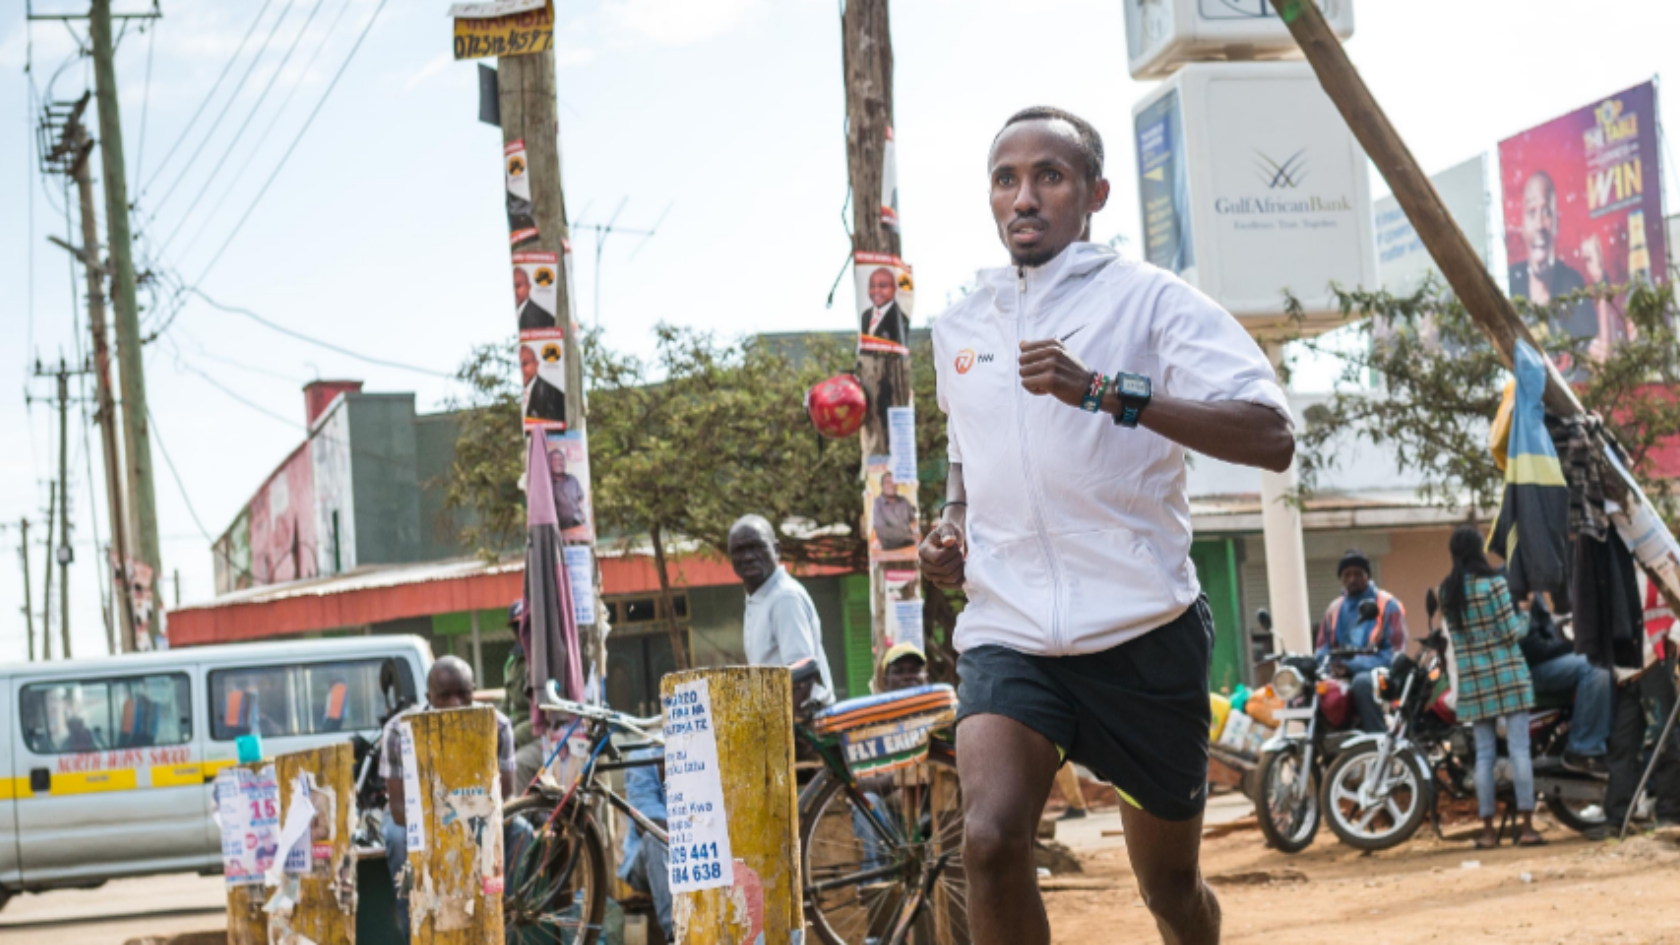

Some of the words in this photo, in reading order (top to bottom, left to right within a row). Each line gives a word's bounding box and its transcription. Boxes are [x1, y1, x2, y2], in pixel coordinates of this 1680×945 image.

[1587, 157, 1642, 212] WIN
[1214, 194, 1353, 215] GulfAfricanBank
[847, 739, 878, 762] FLY
[250, 799, 277, 819] 15
[690, 842, 718, 861] 441
[692, 861, 722, 882] 638
